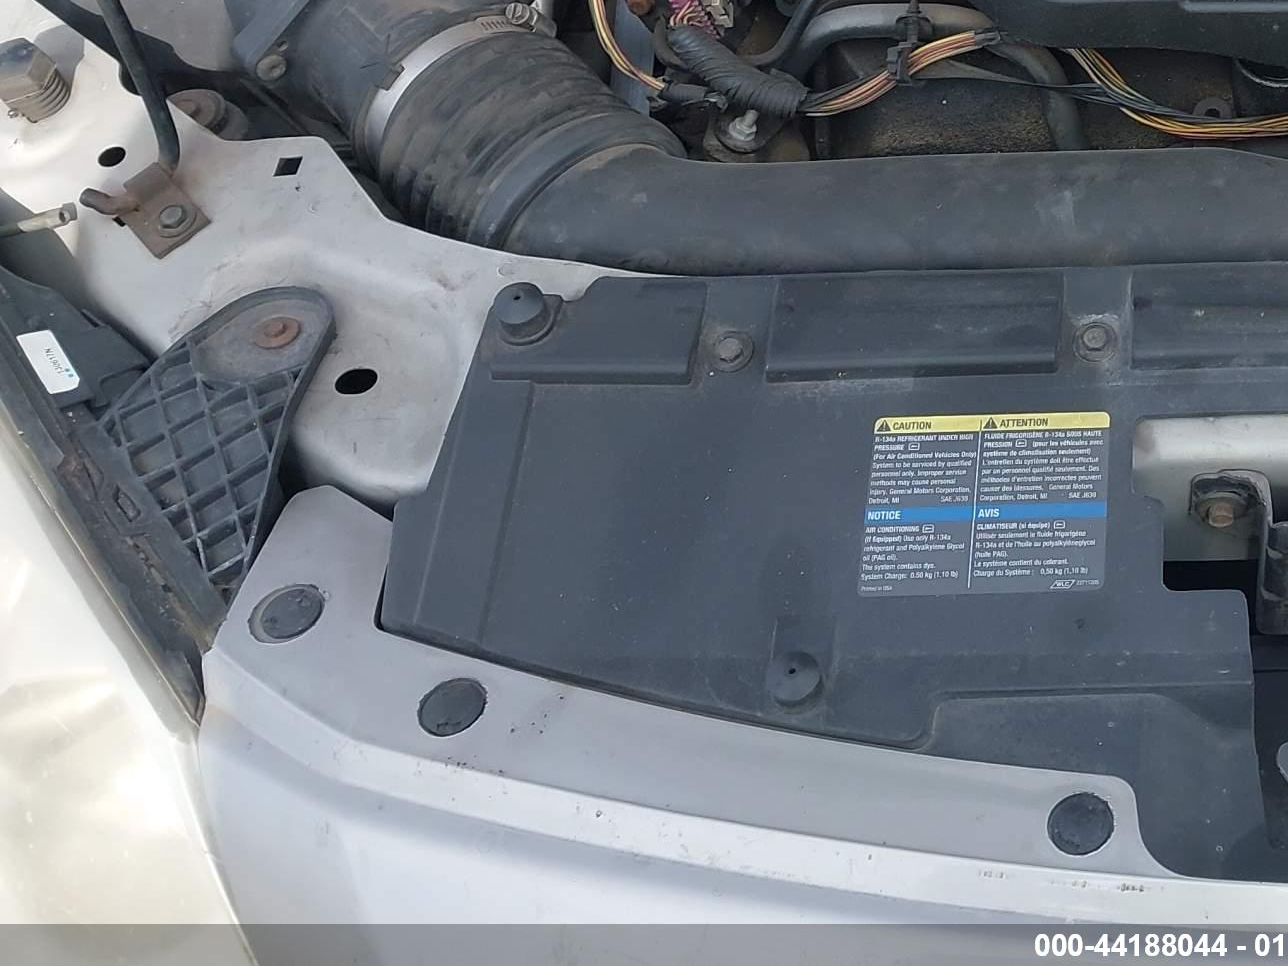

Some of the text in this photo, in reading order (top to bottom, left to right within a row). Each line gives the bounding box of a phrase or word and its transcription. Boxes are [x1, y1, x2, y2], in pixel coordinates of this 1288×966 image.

[893, 421, 932, 430] CAUTION
[1000, 418, 1048, 427] ATTENTION
[868, 511, 901, 520] NOTICE
[978, 509, 1000, 517] AVIS
